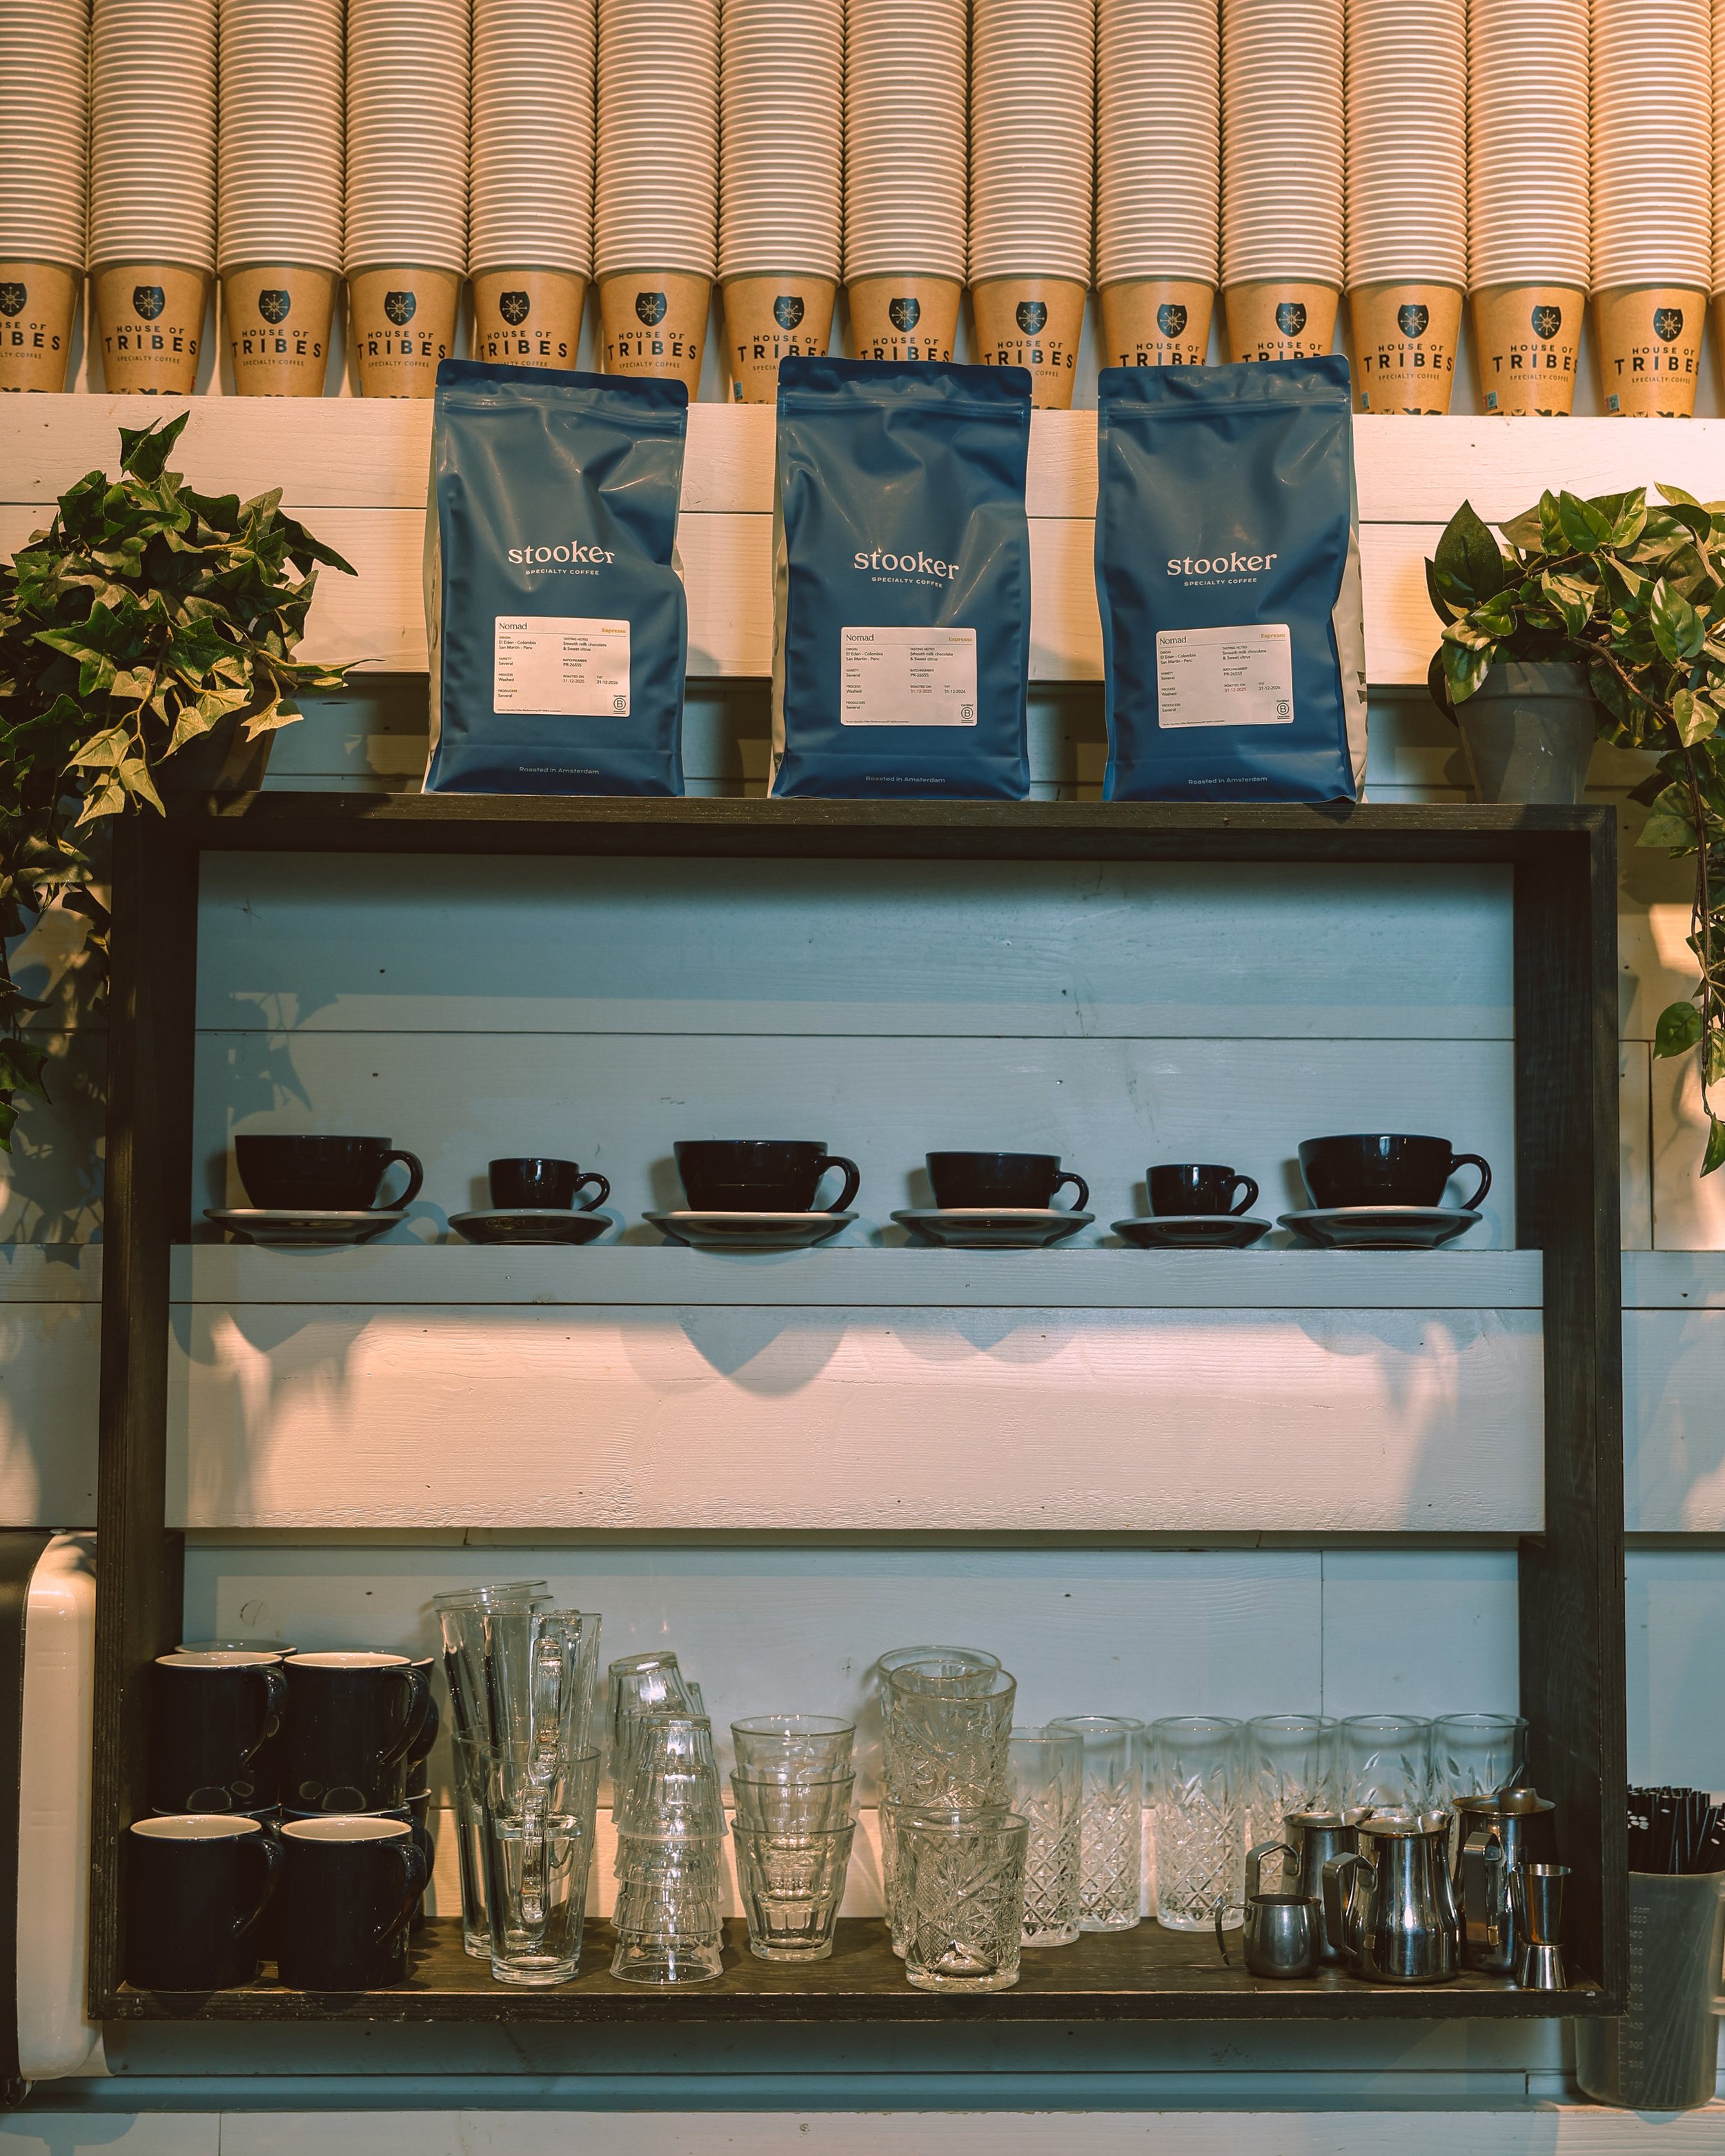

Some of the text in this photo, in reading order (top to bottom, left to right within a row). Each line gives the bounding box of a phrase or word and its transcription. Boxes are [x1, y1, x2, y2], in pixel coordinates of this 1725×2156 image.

[368, 330, 409, 339] HOUSE
[487, 330, 525, 340] HOUSE
[619, 330, 660, 340] HOUSE
[105, 335, 197, 355] TRIBES
[232, 338, 321, 358] TRIBES
[357, 339, 446, 359] TRIBES
[480, 339, 567, 360] TRIBES
[608, 341, 696, 361] TRIBES
[861, 346, 949, 362] TRIBES
[1379, 344, 1422, 352] HOUSE
[985, 350, 1072, 368] TRIBES
[1363, 353, 1452, 373] TRIBES
[1492, 353, 1577, 373] TRIBES
[508, 540, 615, 564] stooker
[854, 551, 959, 580] stooker
[1167, 552, 1277, 575] stooker
[916, 580, 943, 588] COFFEE
[1160, 636, 1187, 644] Nomad
